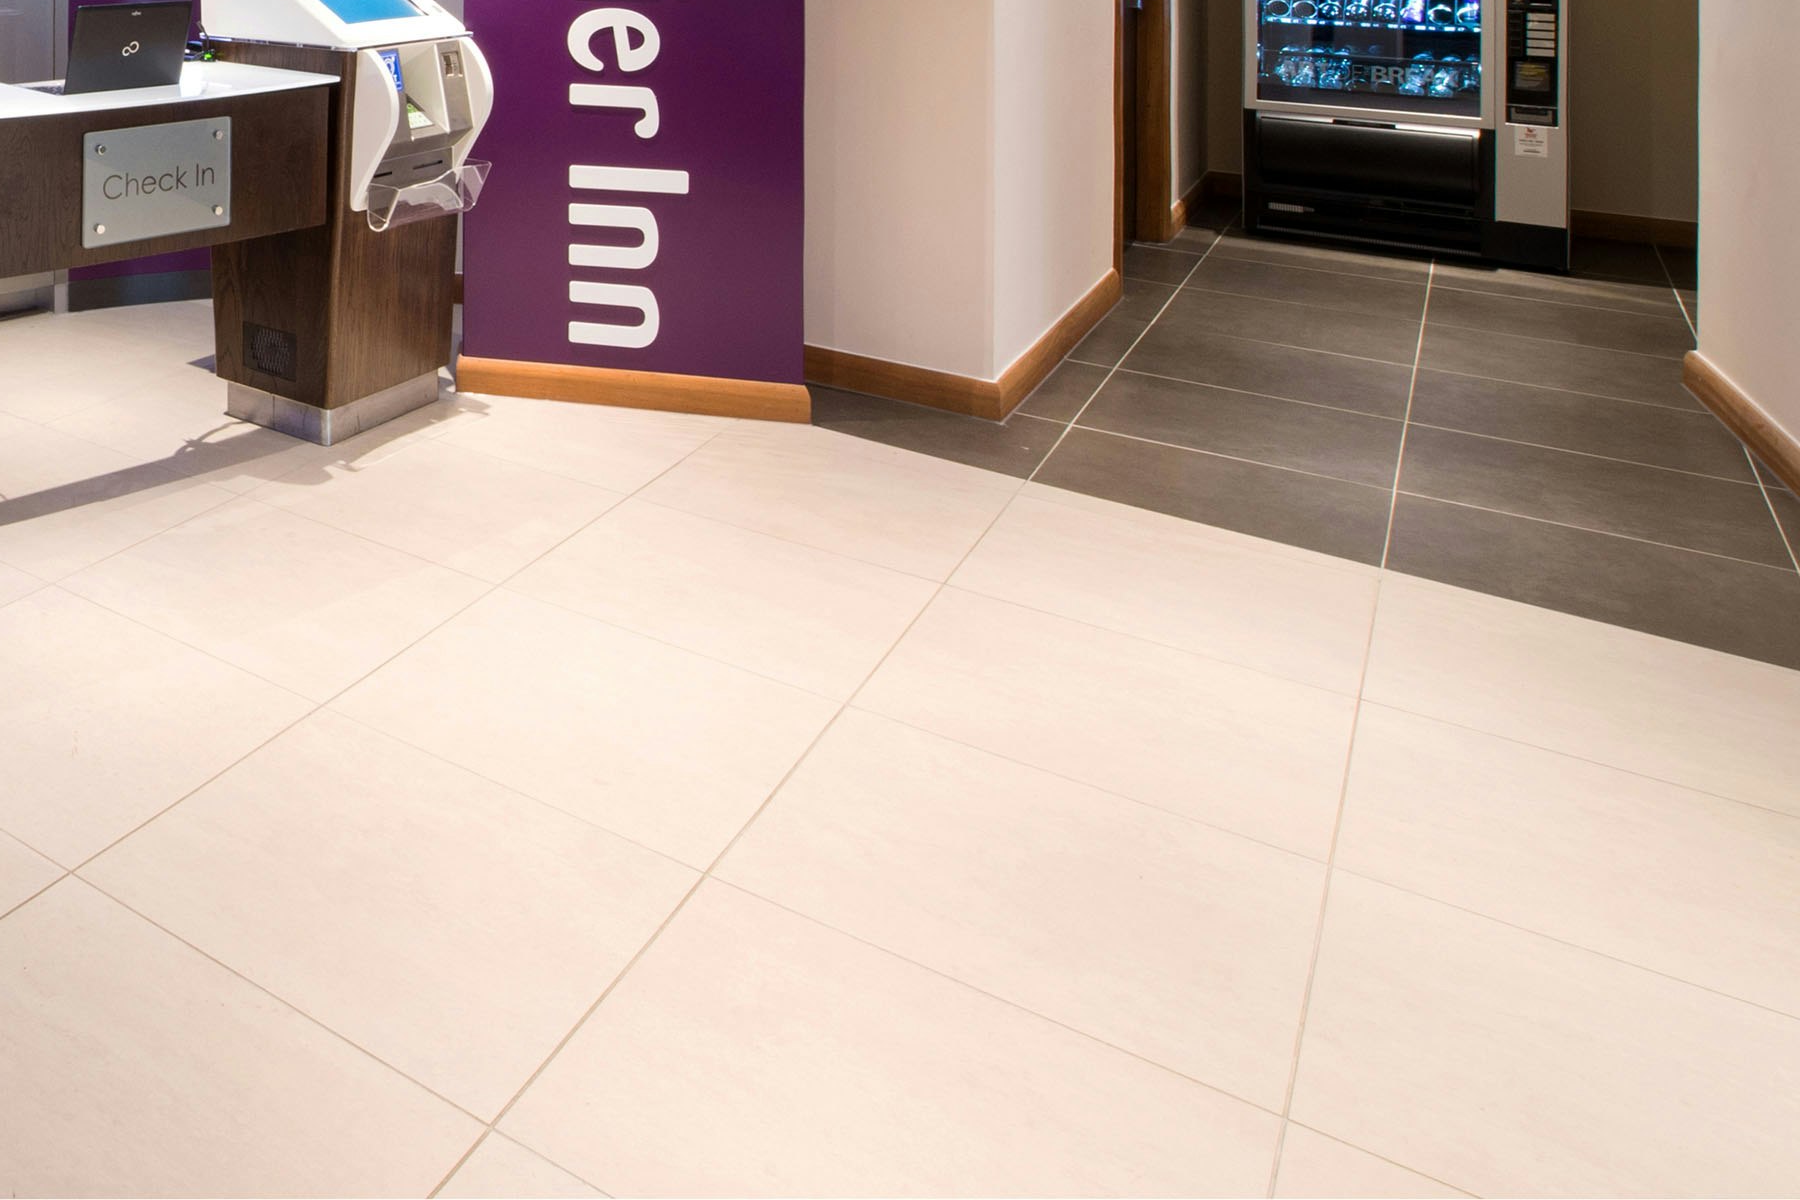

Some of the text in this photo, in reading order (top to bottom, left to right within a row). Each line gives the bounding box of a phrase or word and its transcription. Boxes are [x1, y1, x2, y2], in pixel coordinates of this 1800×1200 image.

[103, 163, 215, 200] Check In
[568, 164, 690, 349] Inn
